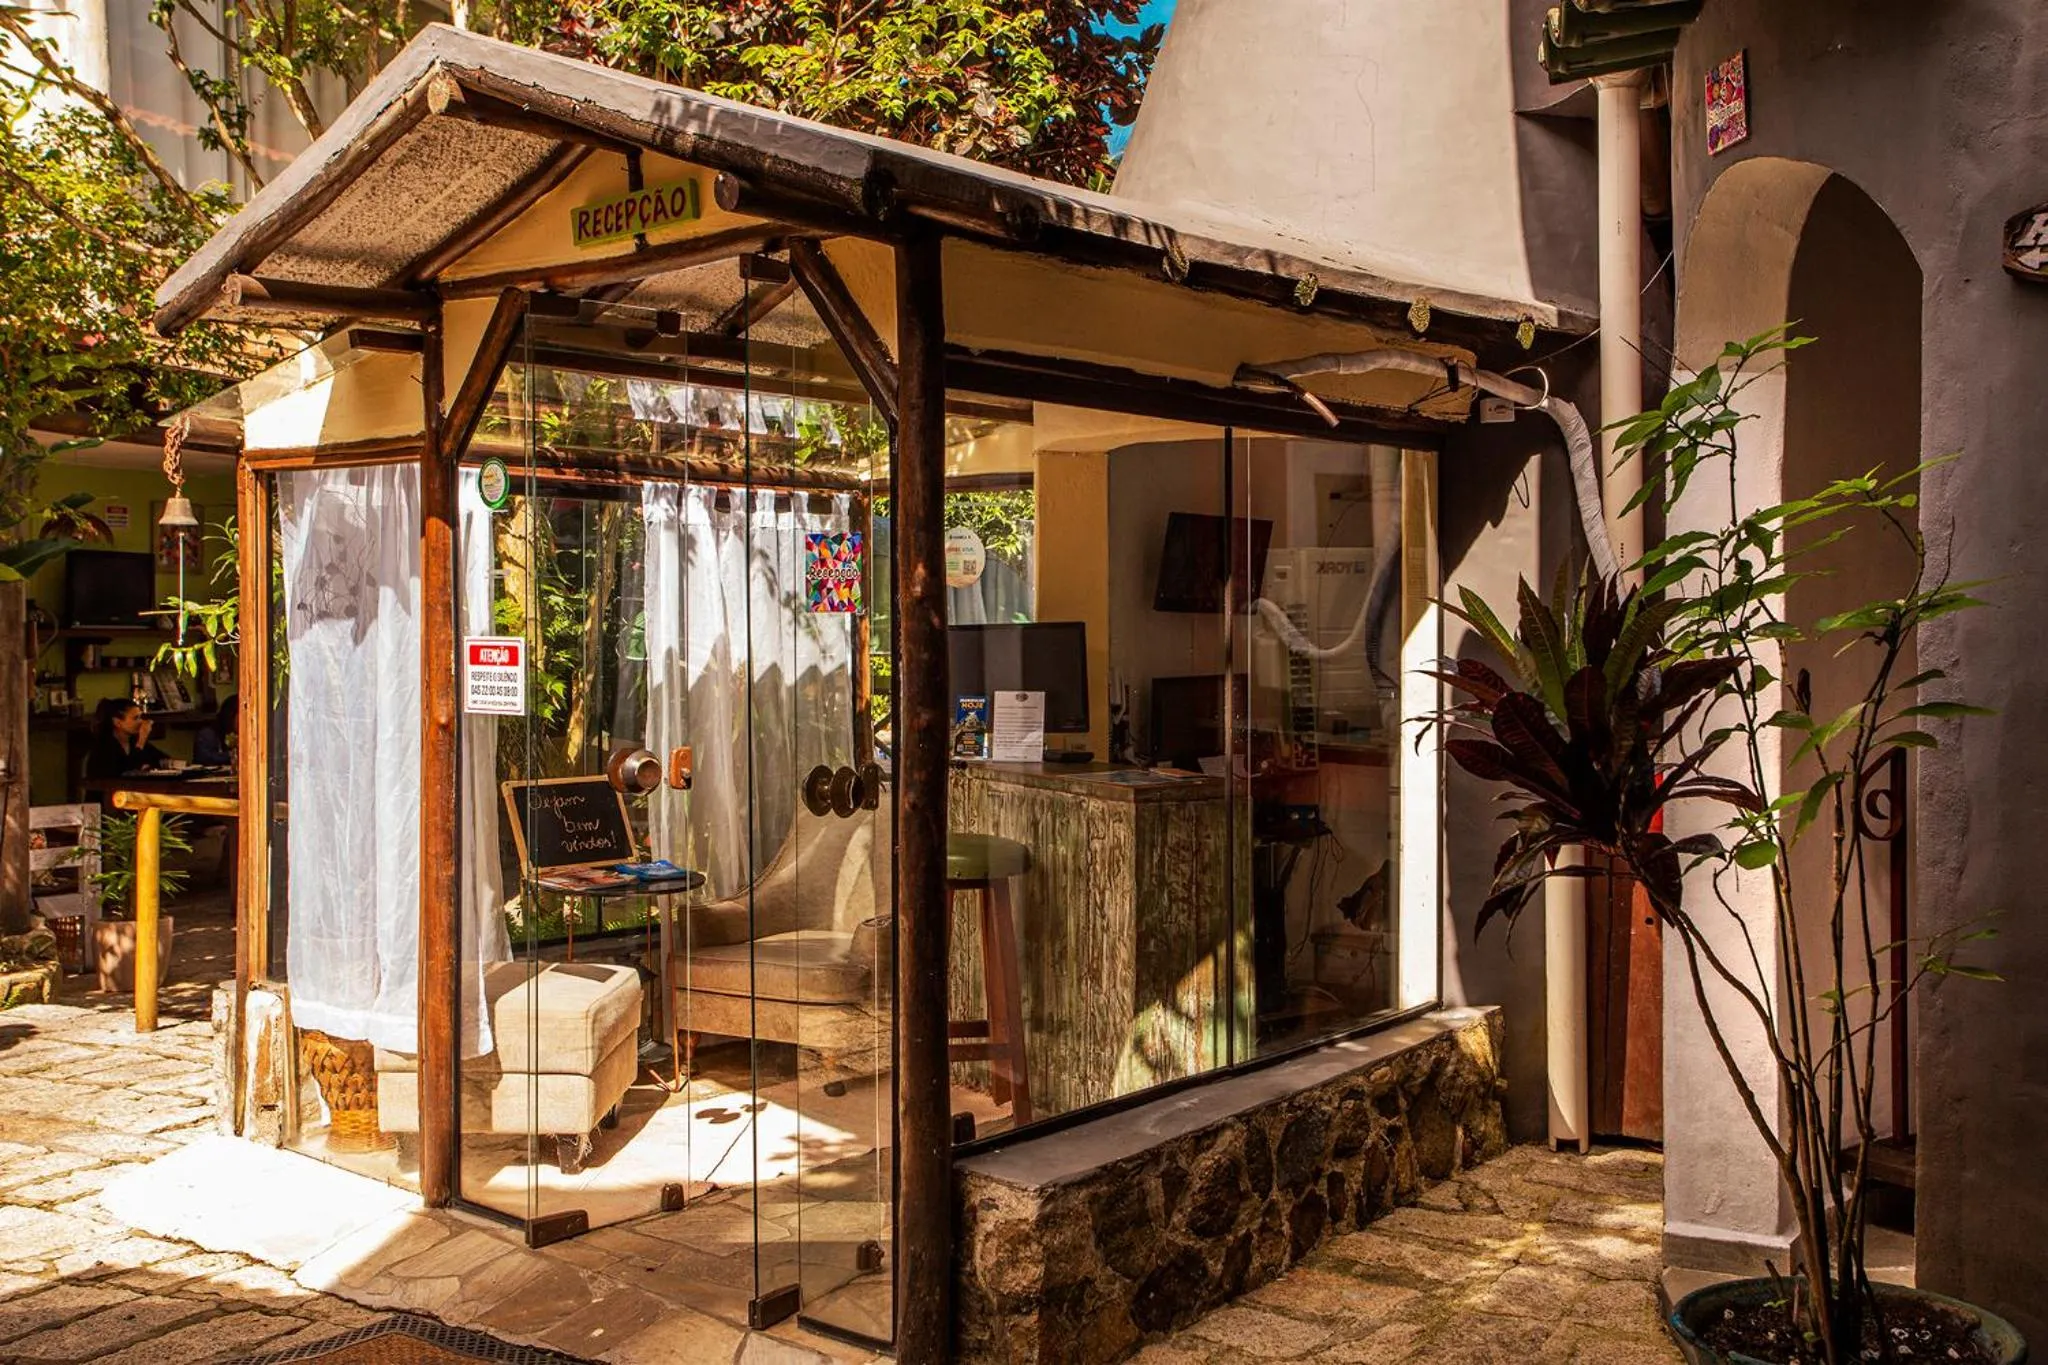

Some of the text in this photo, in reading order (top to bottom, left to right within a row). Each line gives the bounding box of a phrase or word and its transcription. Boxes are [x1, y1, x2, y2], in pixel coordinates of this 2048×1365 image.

[578, 187, 685, 240] RECEPÇÃO
[808, 564, 859, 582] Recepção
[479, 647, 509, 665] ATENÇÃO
